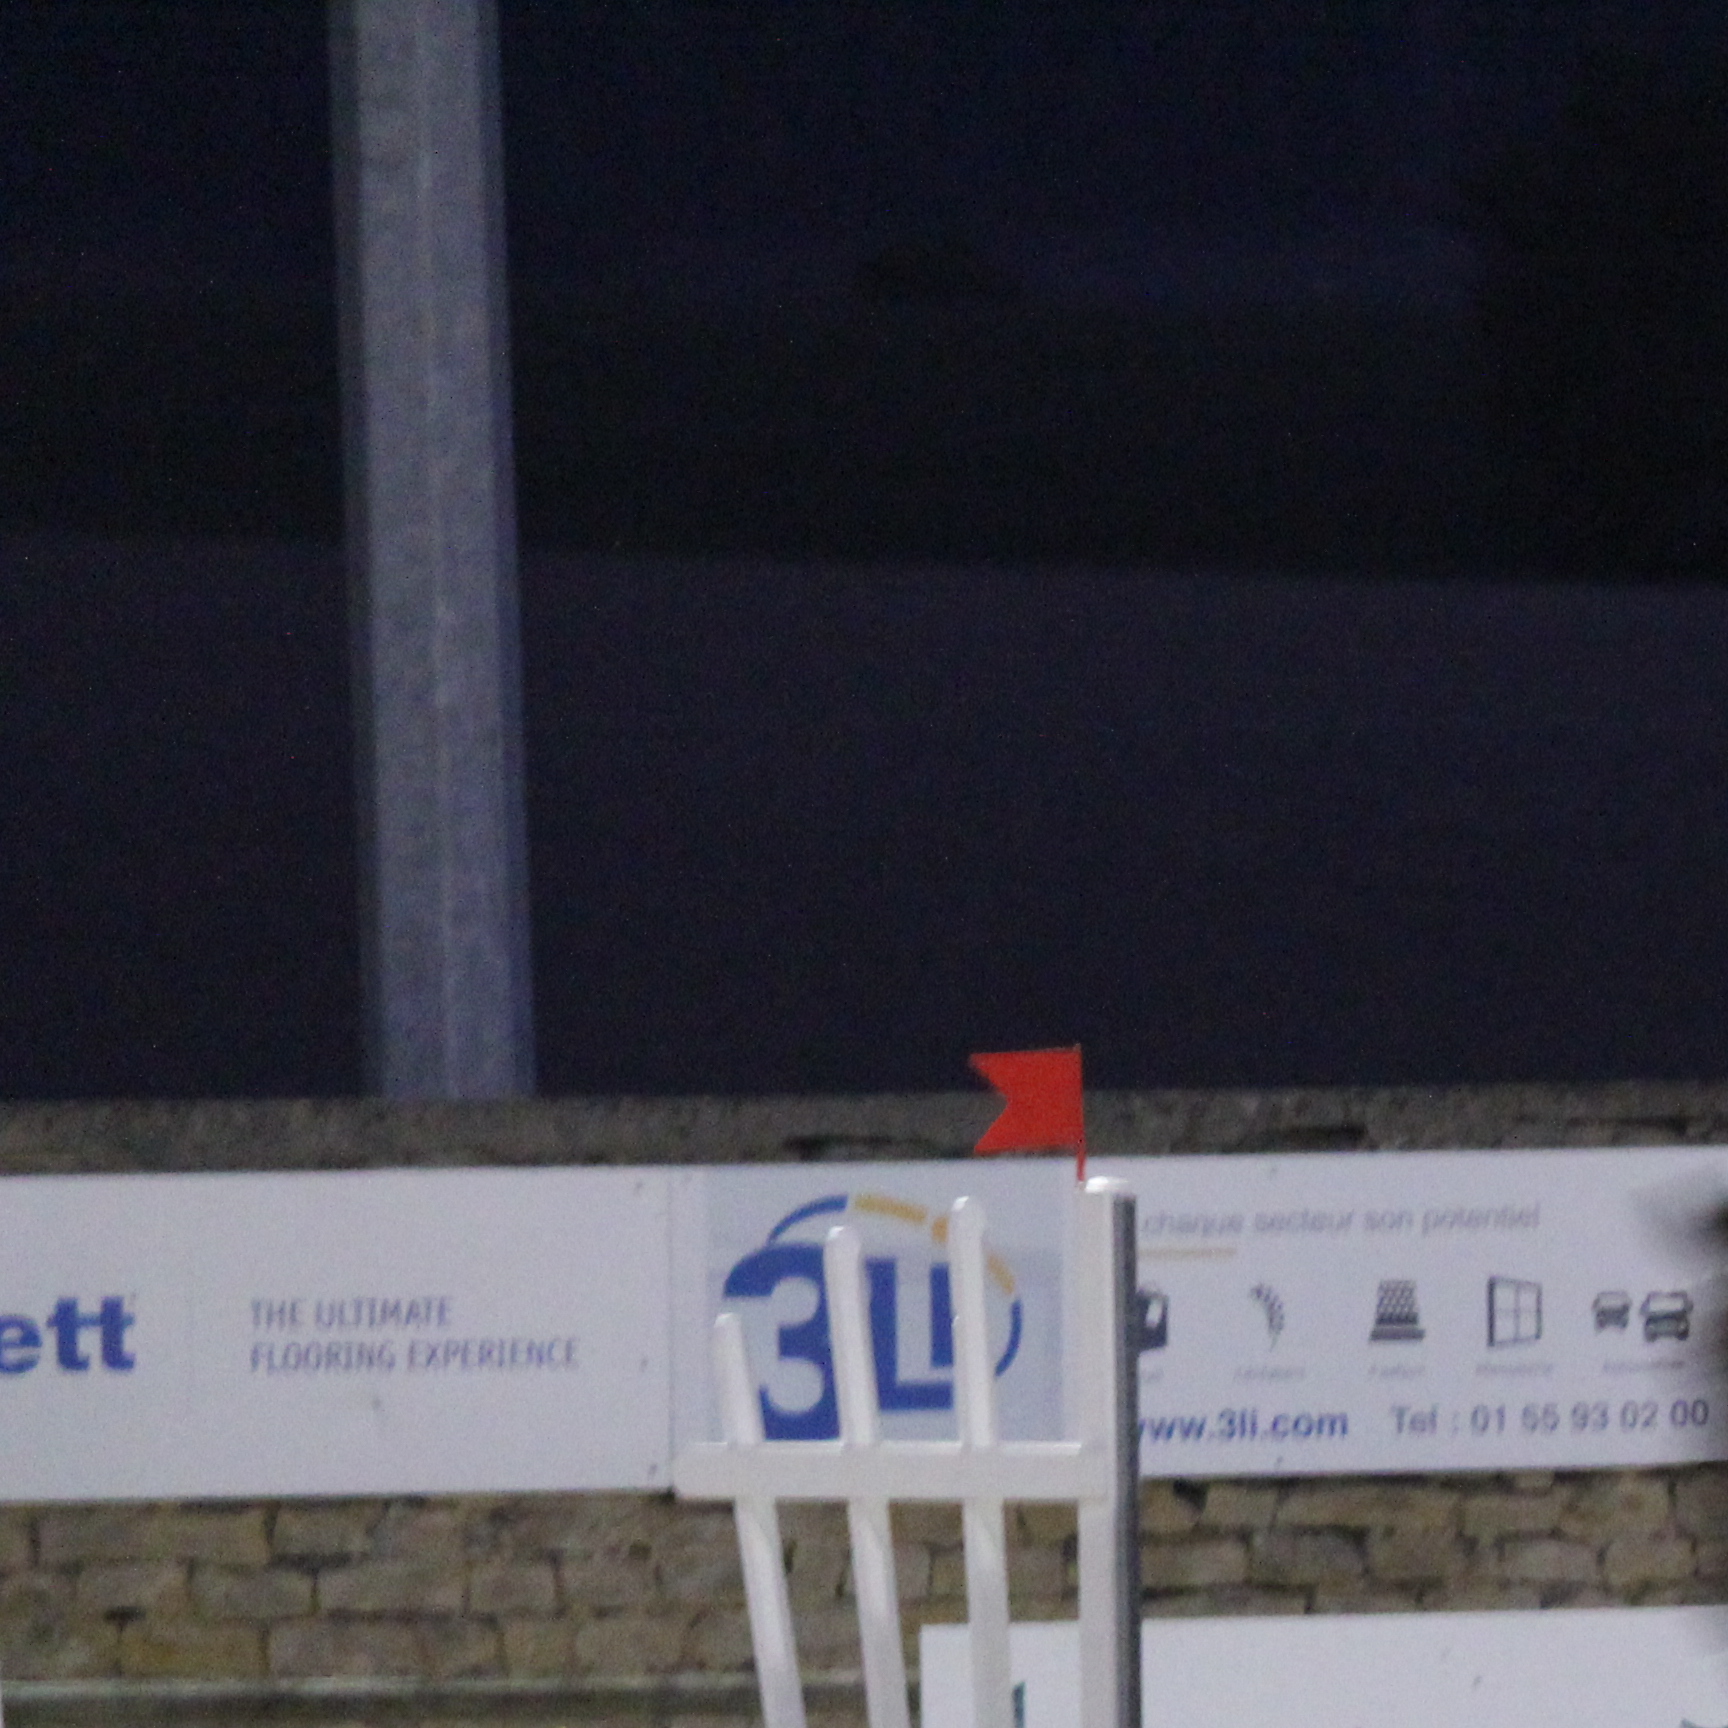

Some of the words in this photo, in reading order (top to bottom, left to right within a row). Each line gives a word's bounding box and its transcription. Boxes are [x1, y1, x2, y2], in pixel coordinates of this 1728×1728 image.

[1253, 1208, 1354, 1233] secteur
[1363, 1208, 1413, 1230] son
[1421, 1202, 1541, 1233] potentiel
[250, 1299, 303, 1328] THE
[314, 1296, 452, 1328] ULTIMATE
[250, 1341, 396, 1373] FLOORING
[407, 1338, 580, 1370] EXPERIENCE
[1138, 1407, 1348, 1442] ww.3li.com
[1391, 1403, 1438, 1436] Tel
[1471, 1404, 1508, 1434] 01
[1619, 1400, 1659, 1429] 02
[1670, 1399, 1710, 1427] 00
